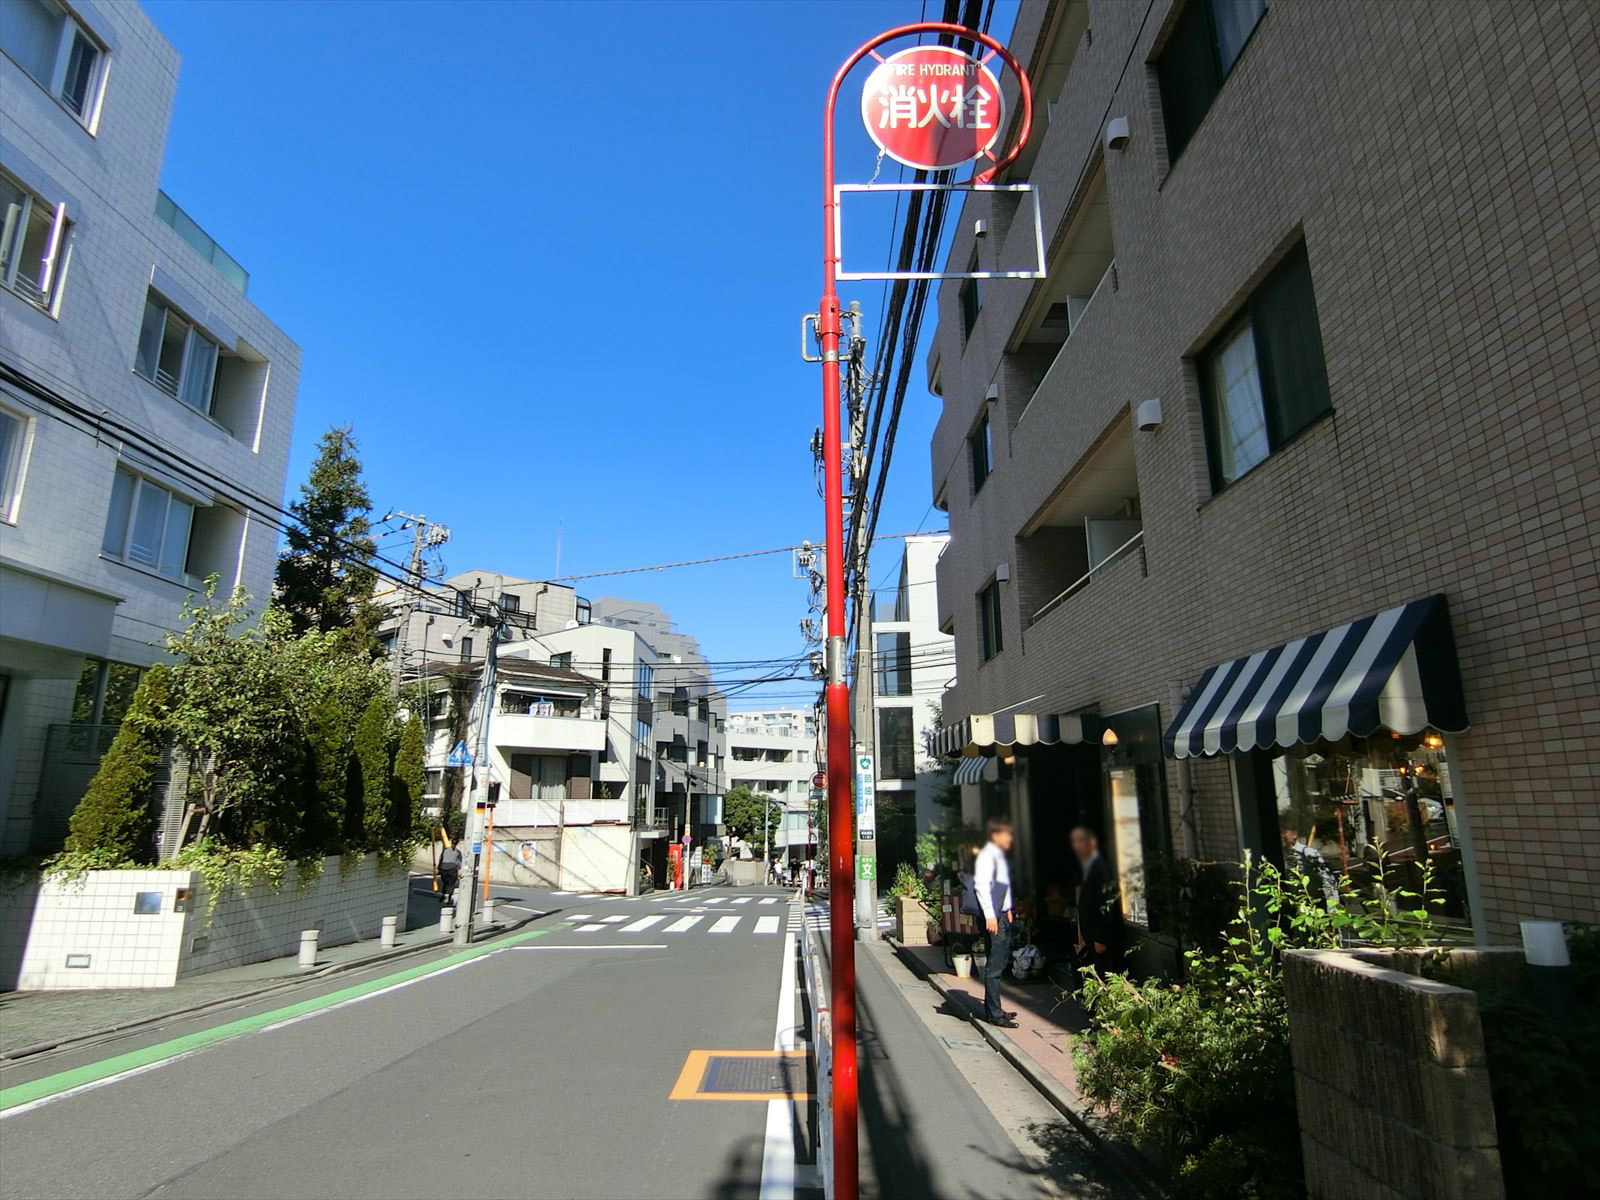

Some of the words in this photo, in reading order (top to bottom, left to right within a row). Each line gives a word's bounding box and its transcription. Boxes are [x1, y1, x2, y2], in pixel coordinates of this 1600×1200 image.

[919, 63, 976, 76] HYDRANT
[878, 84, 992, 129] 消火栓
